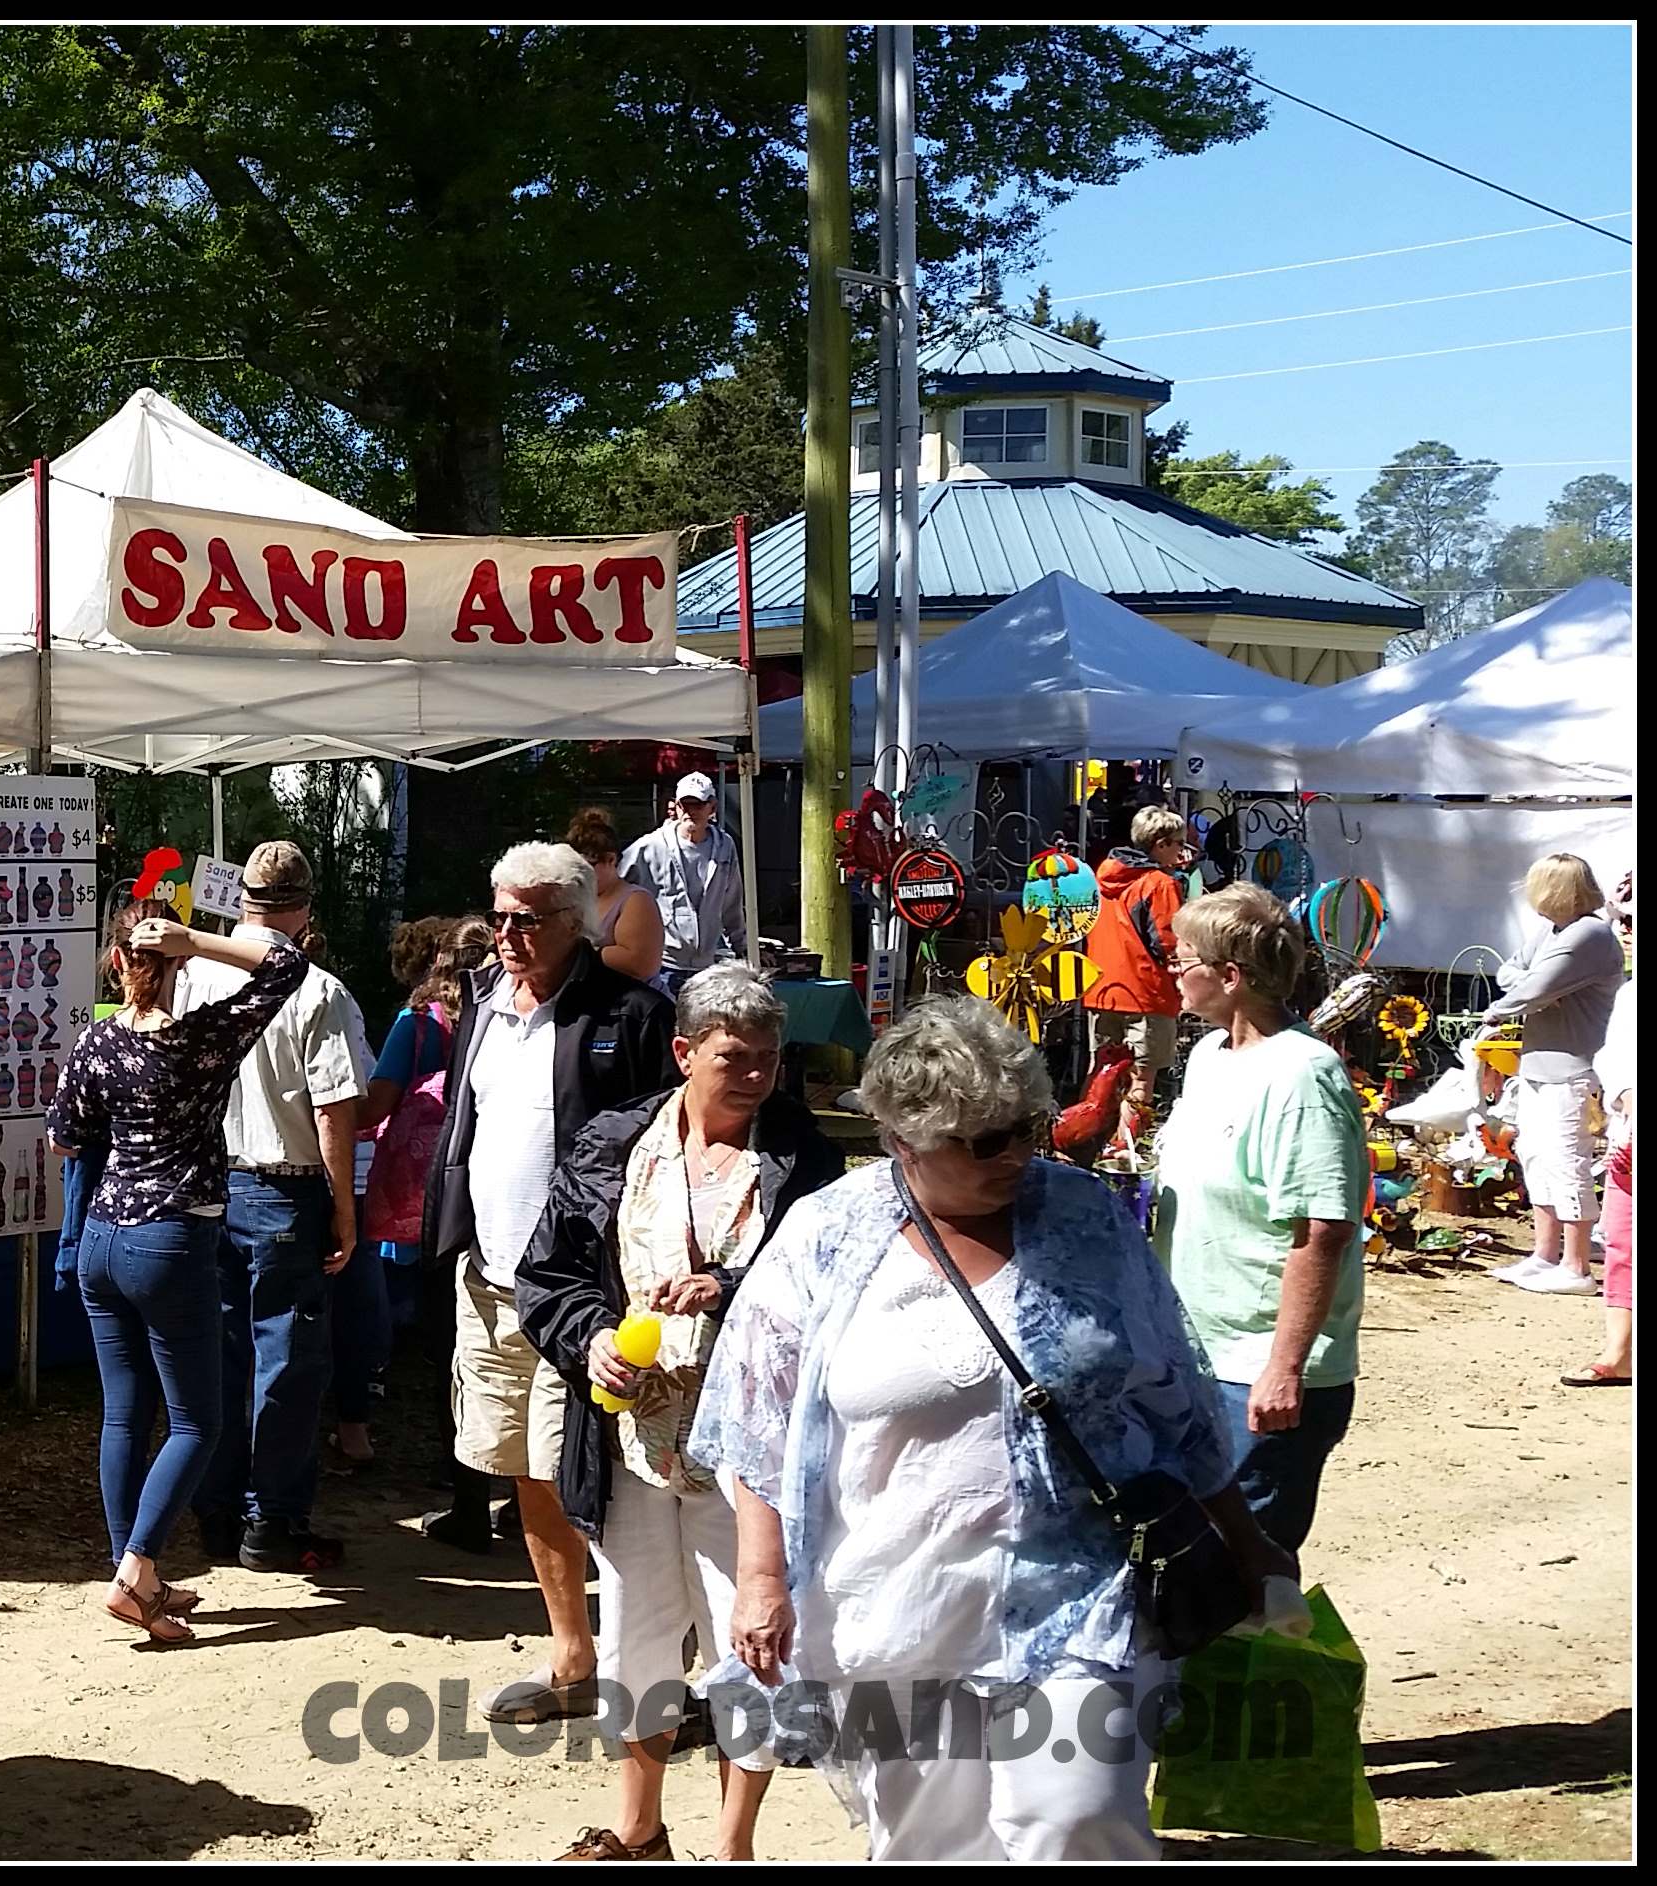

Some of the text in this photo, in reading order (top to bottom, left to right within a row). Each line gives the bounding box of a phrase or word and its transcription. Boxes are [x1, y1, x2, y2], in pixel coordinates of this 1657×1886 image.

[121, 527, 666, 645] SAND ART
[33, 796, 54, 810] ONE
[59, 797, 94, 812] TODAY!
[72, 828, 92, 850] $4
[205, 862, 236, 880] Sand
[76, 883, 96, 906] $5
[69, 1006, 90, 1028] $6
